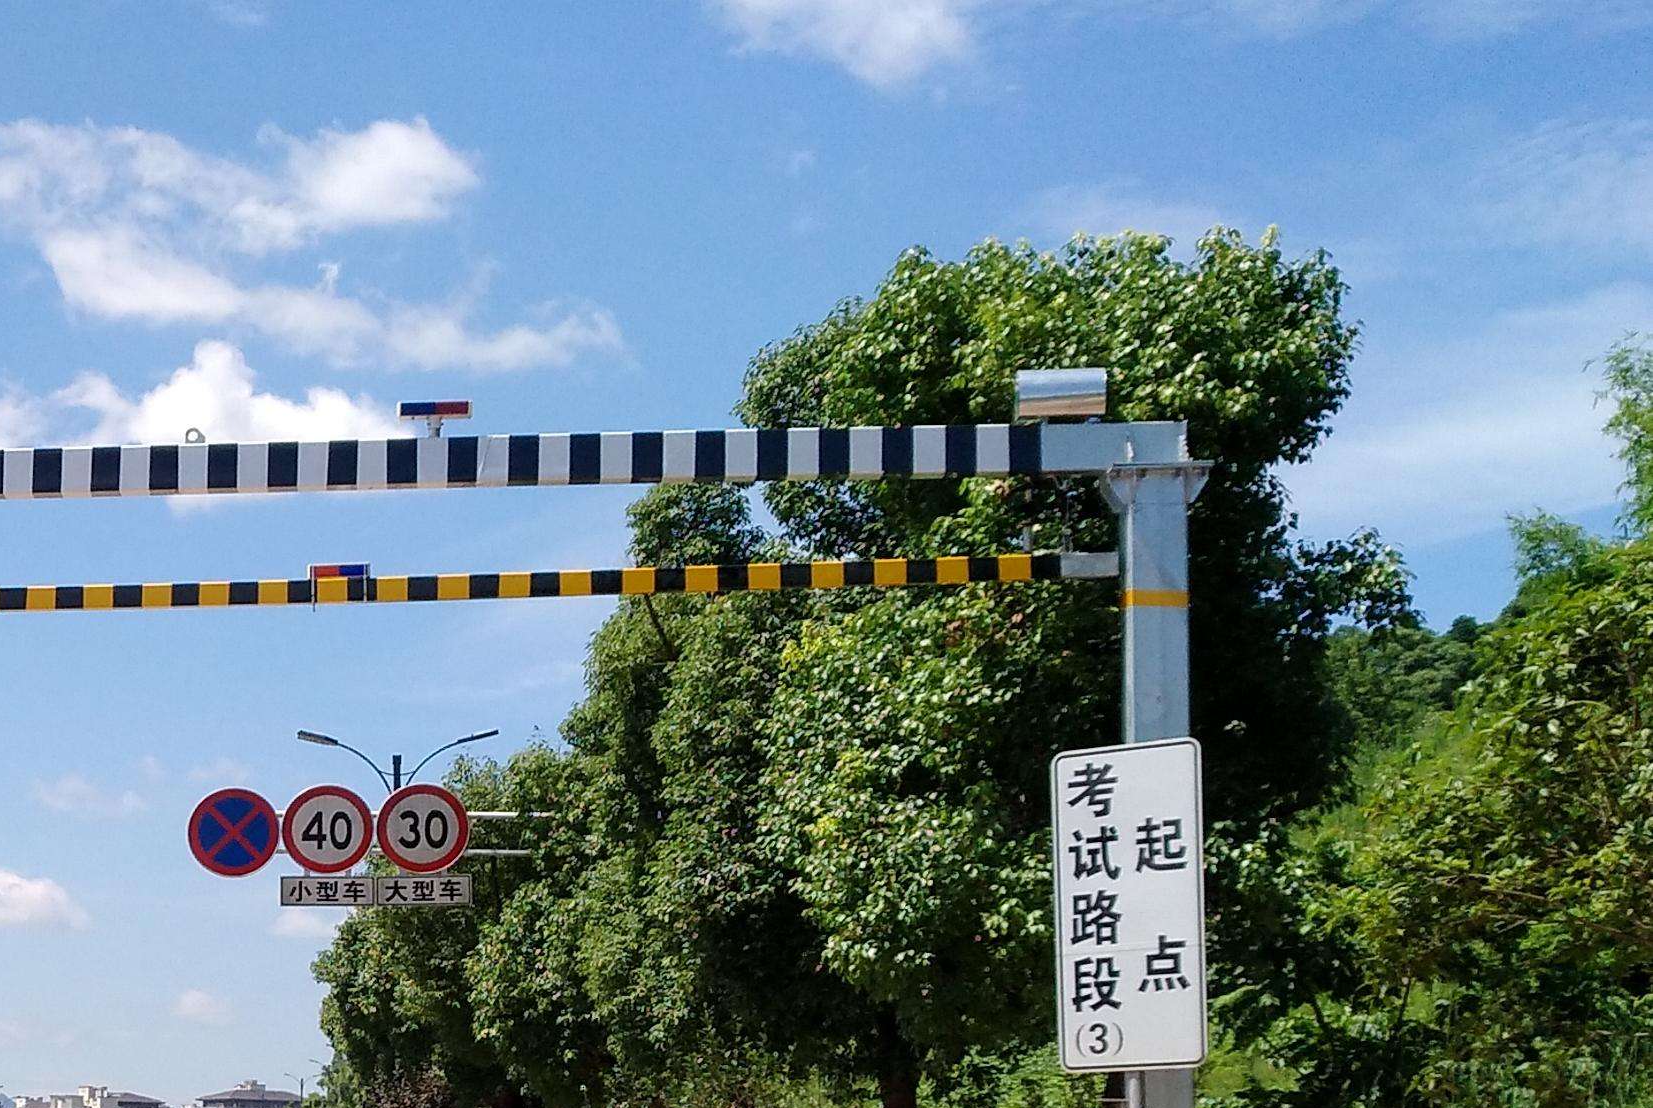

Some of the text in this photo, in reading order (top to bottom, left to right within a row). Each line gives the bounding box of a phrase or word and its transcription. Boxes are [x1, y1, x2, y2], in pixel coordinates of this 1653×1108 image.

[301, 811, 352, 850] 40
[398, 809, 447, 850] 30
[289, 880, 367, 903] 小型车
[384, 880, 463, 903] 大型车
